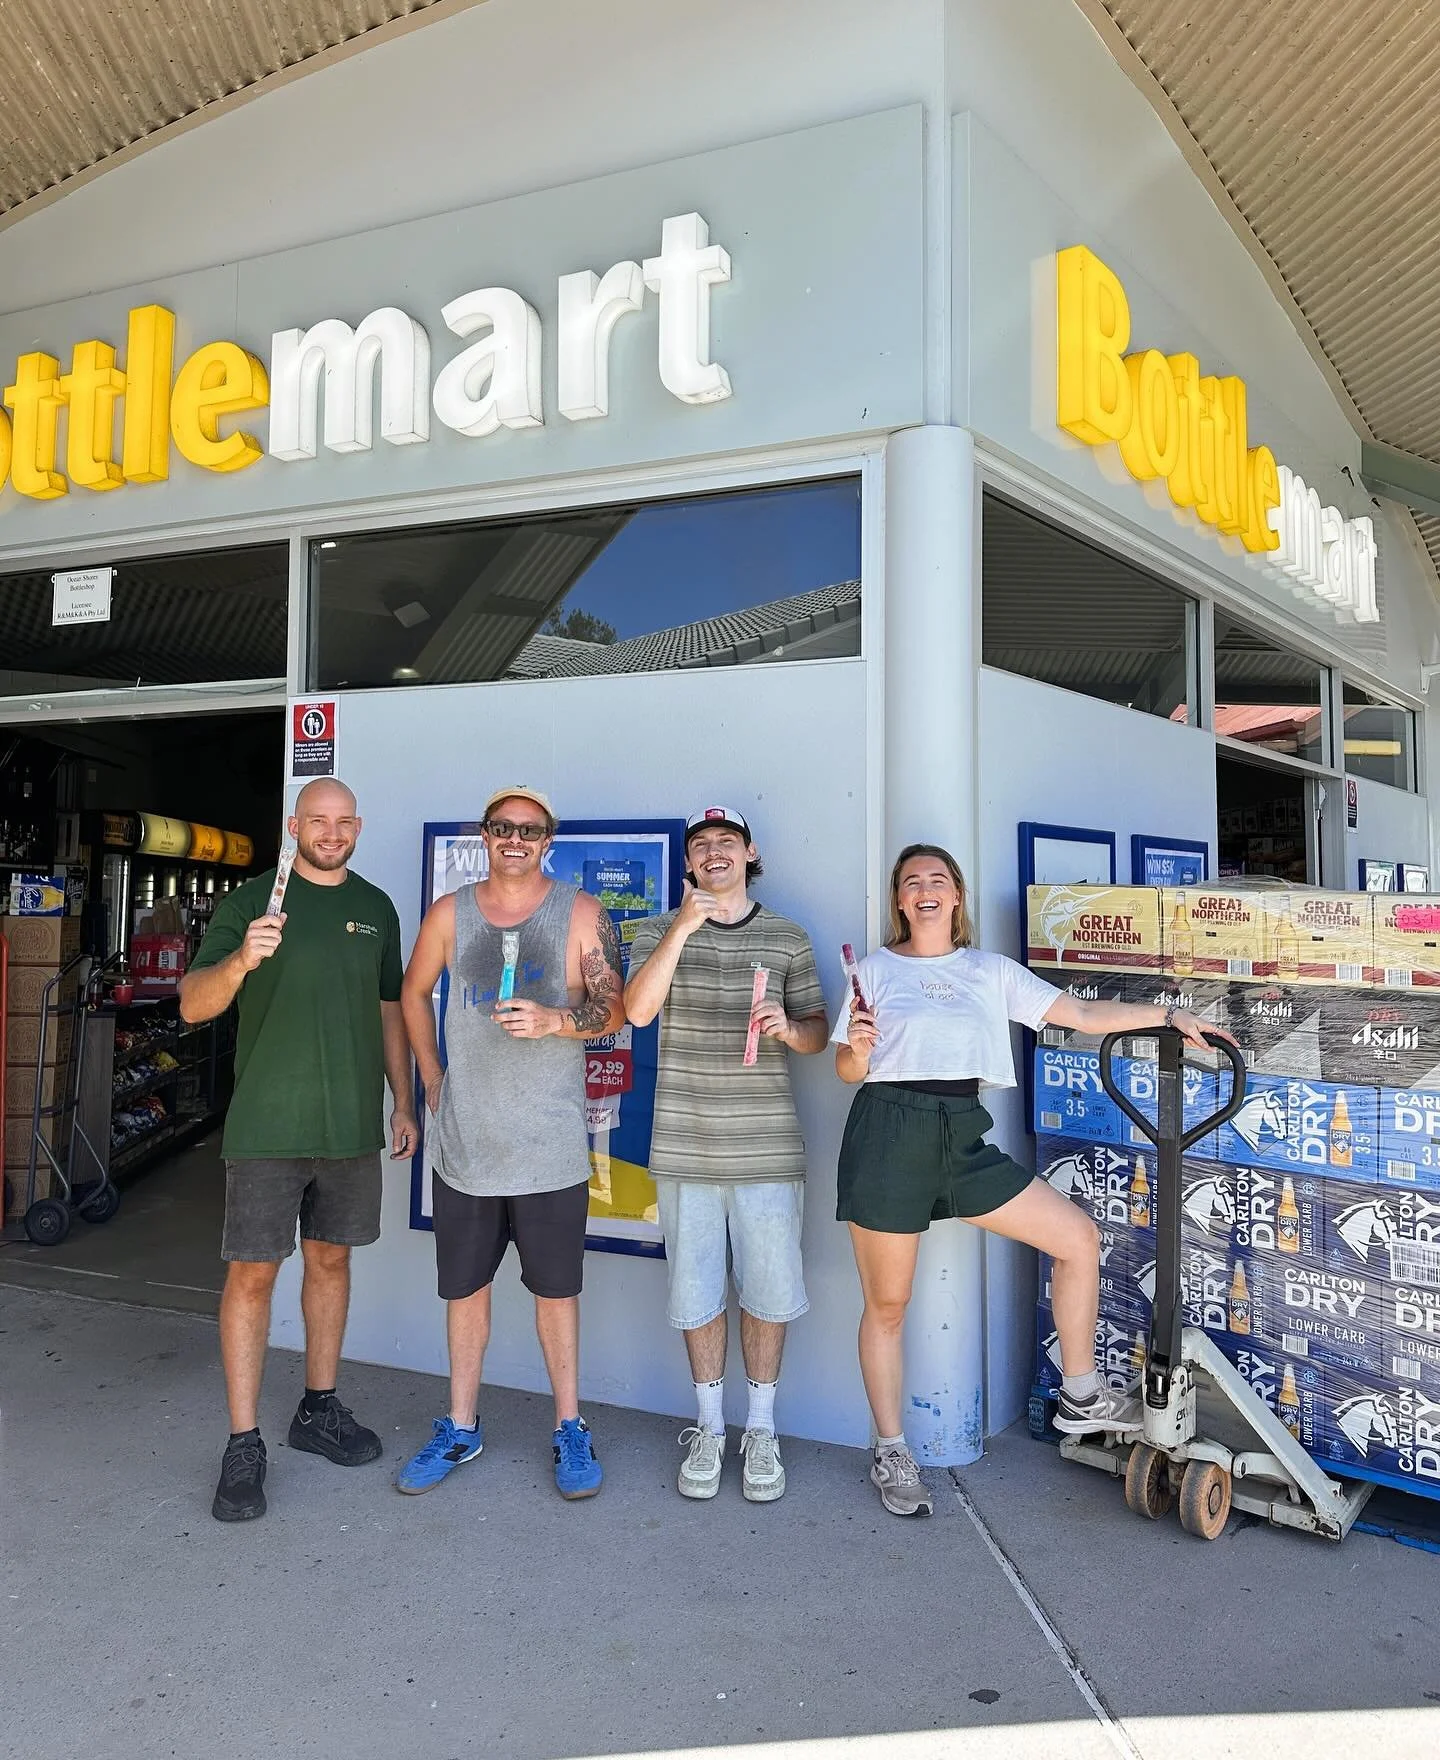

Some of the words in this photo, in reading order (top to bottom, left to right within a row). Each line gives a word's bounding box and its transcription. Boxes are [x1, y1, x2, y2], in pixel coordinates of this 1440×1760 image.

[0, 212, 733, 500] ttlemart
[1057, 244, 1380, 623] Bottlemart
[596, 872, 630, 881] SUMMER
[1192, 909, 1250, 922] NORTHERN
[1198, 897, 1242, 911] GREAT
[1304, 900, 1354, 915] GREAT
[1080, 914, 1133, 931] GREAT
[1298, 914, 1360, 926] NORTHERN
[1072, 930, 1141, 944] NORTHERN
[1064, 984, 1098, 1000] Asahi
[1153, 990, 1193, 1008] Asahi
[1250, 1000, 1292, 1018] Asahi
[1352, 1022, 1419, 1050] Asahi
[1044, 1052, 1100, 1070] CARLTO
[1373, 1050, 1396, 1060] 辛口
[585, 1060, 624, 1083] 2.99
[602, 1076, 623, 1085] EACH
[1044, 1064, 1104, 1093] DRY
[1394, 1092, 1440, 1110] CARL
[1287, 1082, 1299, 1160] CARLTON
[1302, 1083, 1327, 1164] DRY
[1094, 1146, 1106, 1220] CARLTON
[1107, 1148, 1128, 1224] DRY
[1236, 1168, 1250, 1246] CARLTON
[1251, 1169, 1275, 1250] DRY
[1303, 1202, 1312, 1224] CARB
[1303, 1227, 1312, 1256] LOWER
[1190, 1248, 1202, 1326] CARLTON
[1203, 1252, 1226, 1330] DRY
[1284, 1268, 1366, 1294] CARLTON
[1253, 1285, 1263, 1307] CARB
[1285, 1282, 1366, 1318] DRY
[1395, 1287, 1440, 1308] CARL
[1253, 1308, 1263, 1338] LOWER
[1289, 1317, 1329, 1337] LOWER
[1334, 1327, 1366, 1345] CARB
[1304, 1391, 1313, 1414] CARB
[1304, 1417, 1313, 1446] LOWER
[1399, 1387, 1414, 1472] CARLTON
[1416, 1390, 1440, 1478] DRY
